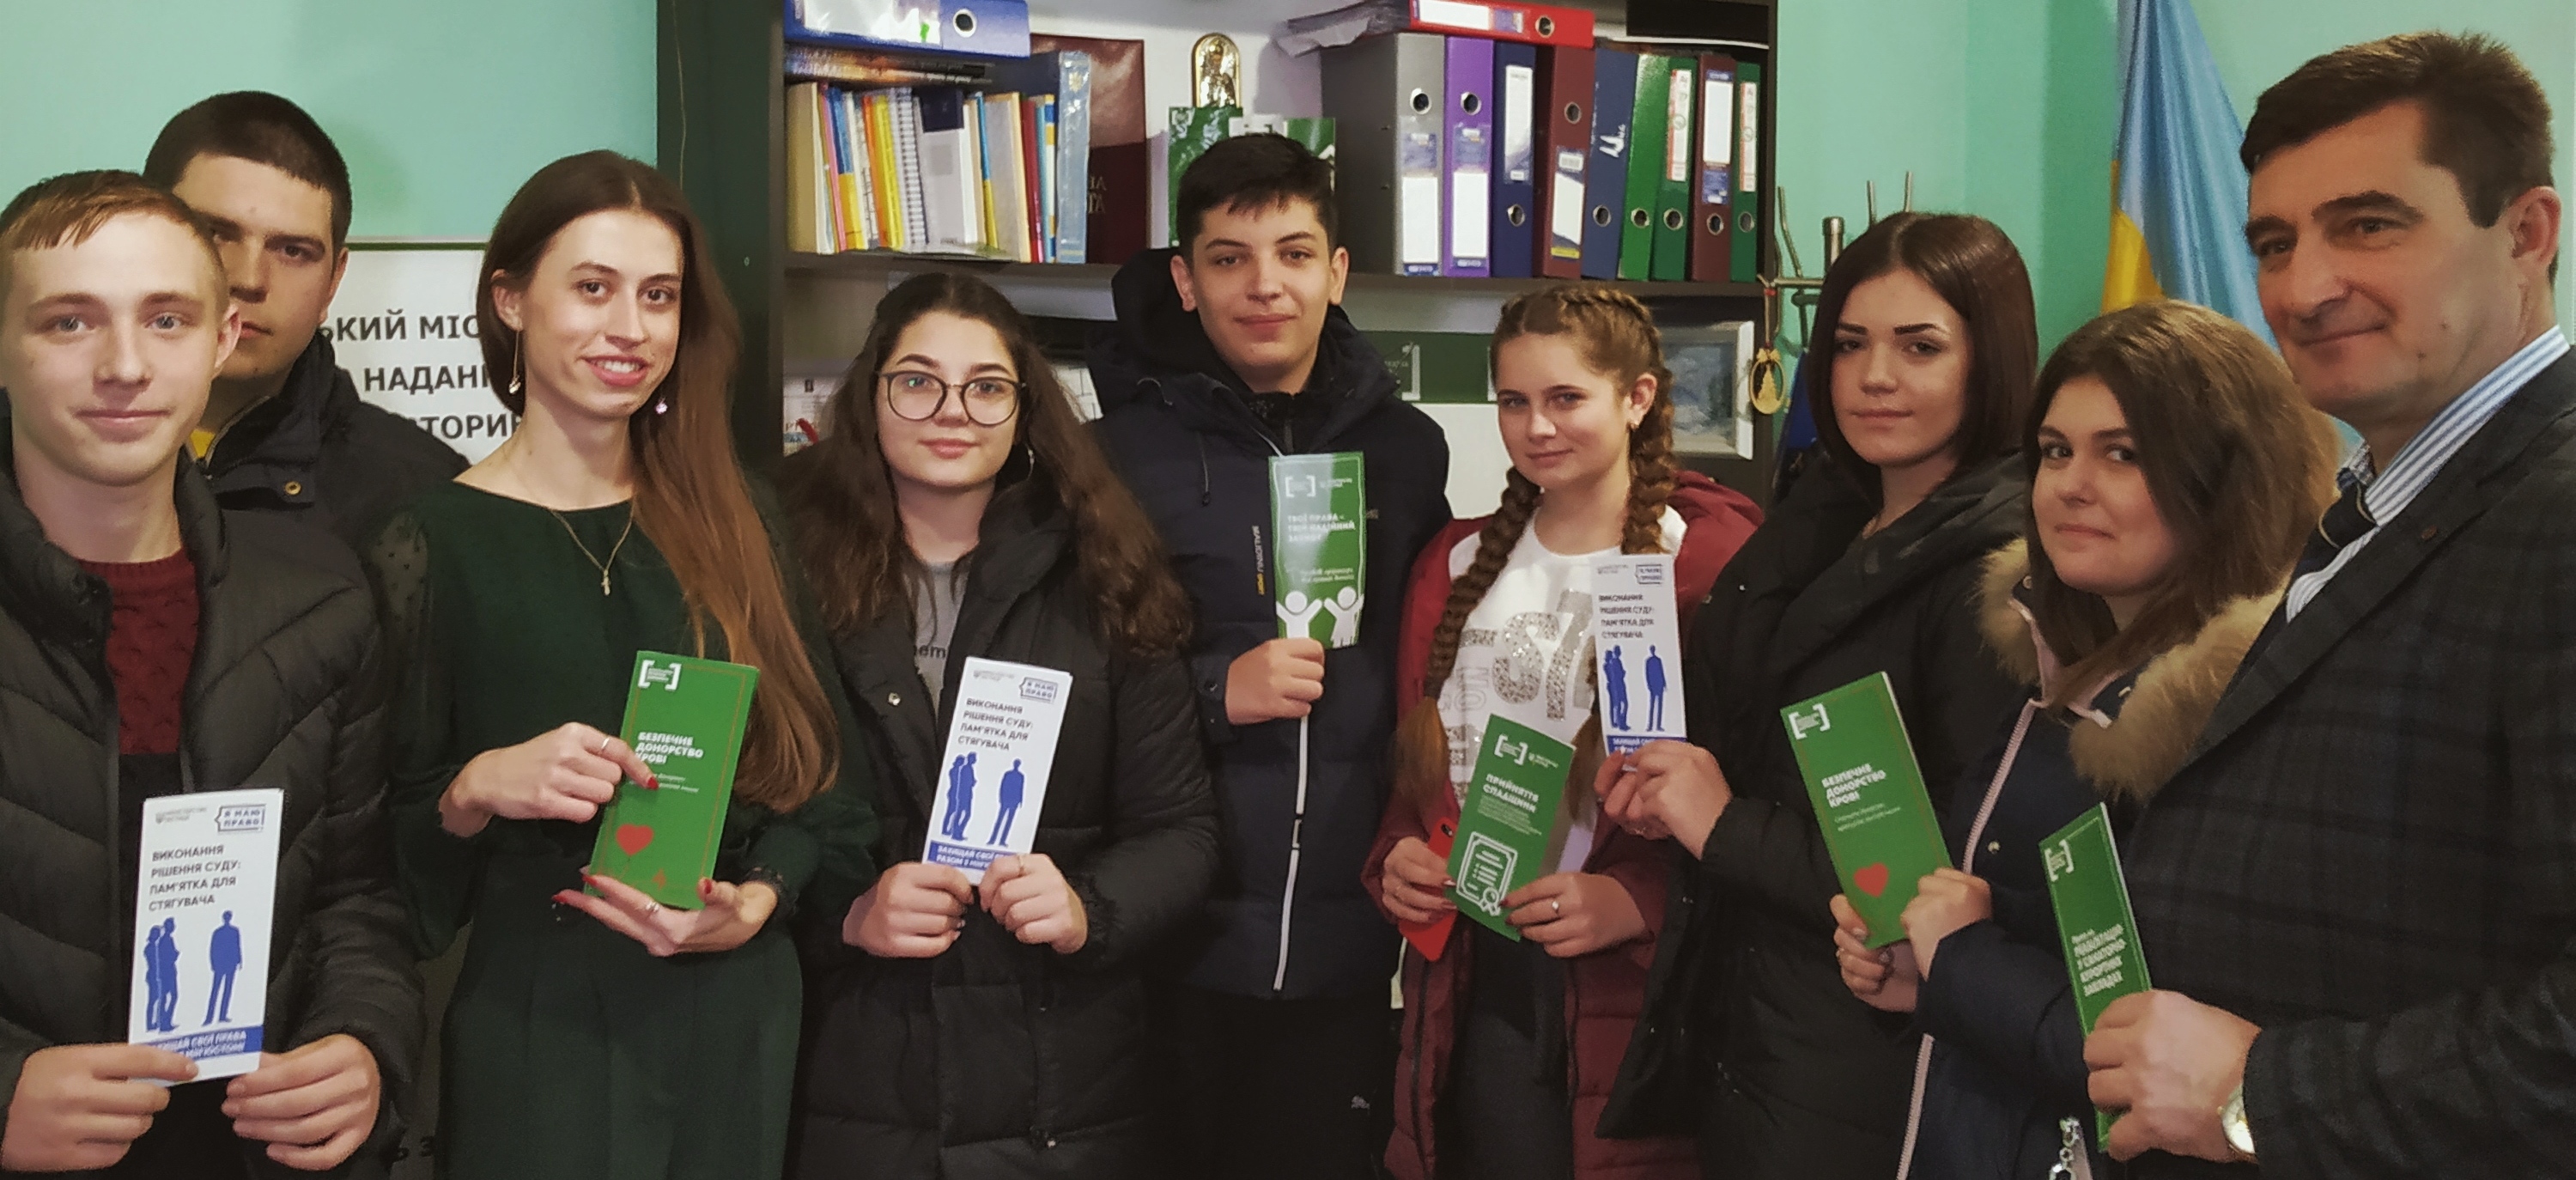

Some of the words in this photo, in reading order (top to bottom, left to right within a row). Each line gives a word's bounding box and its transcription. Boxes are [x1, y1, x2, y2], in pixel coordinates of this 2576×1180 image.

[966, 697, 1024, 714] ВИКОНАННЯ
[963, 710, 1005, 724] РІШЕННЯ
[637, 732, 694, 746] БЕЗПЕЧНЕ
[957, 735, 1010, 751] СТЯГУВАЧА
[1008, 733, 1029, 741] ДЛЯ
[635, 742, 704, 758] ДОНОРСТВО
[223, 818, 259, 827] ПРАВО
[152, 844, 224, 861] ВИКОНАННЯ
[151, 863, 202, 879] РІШЕННЯ
[204, 860, 241, 873] СУДУ:
[210, 876, 236, 890] ДЛЯ
[149, 894, 216, 911] СТЯГУВАЧА
